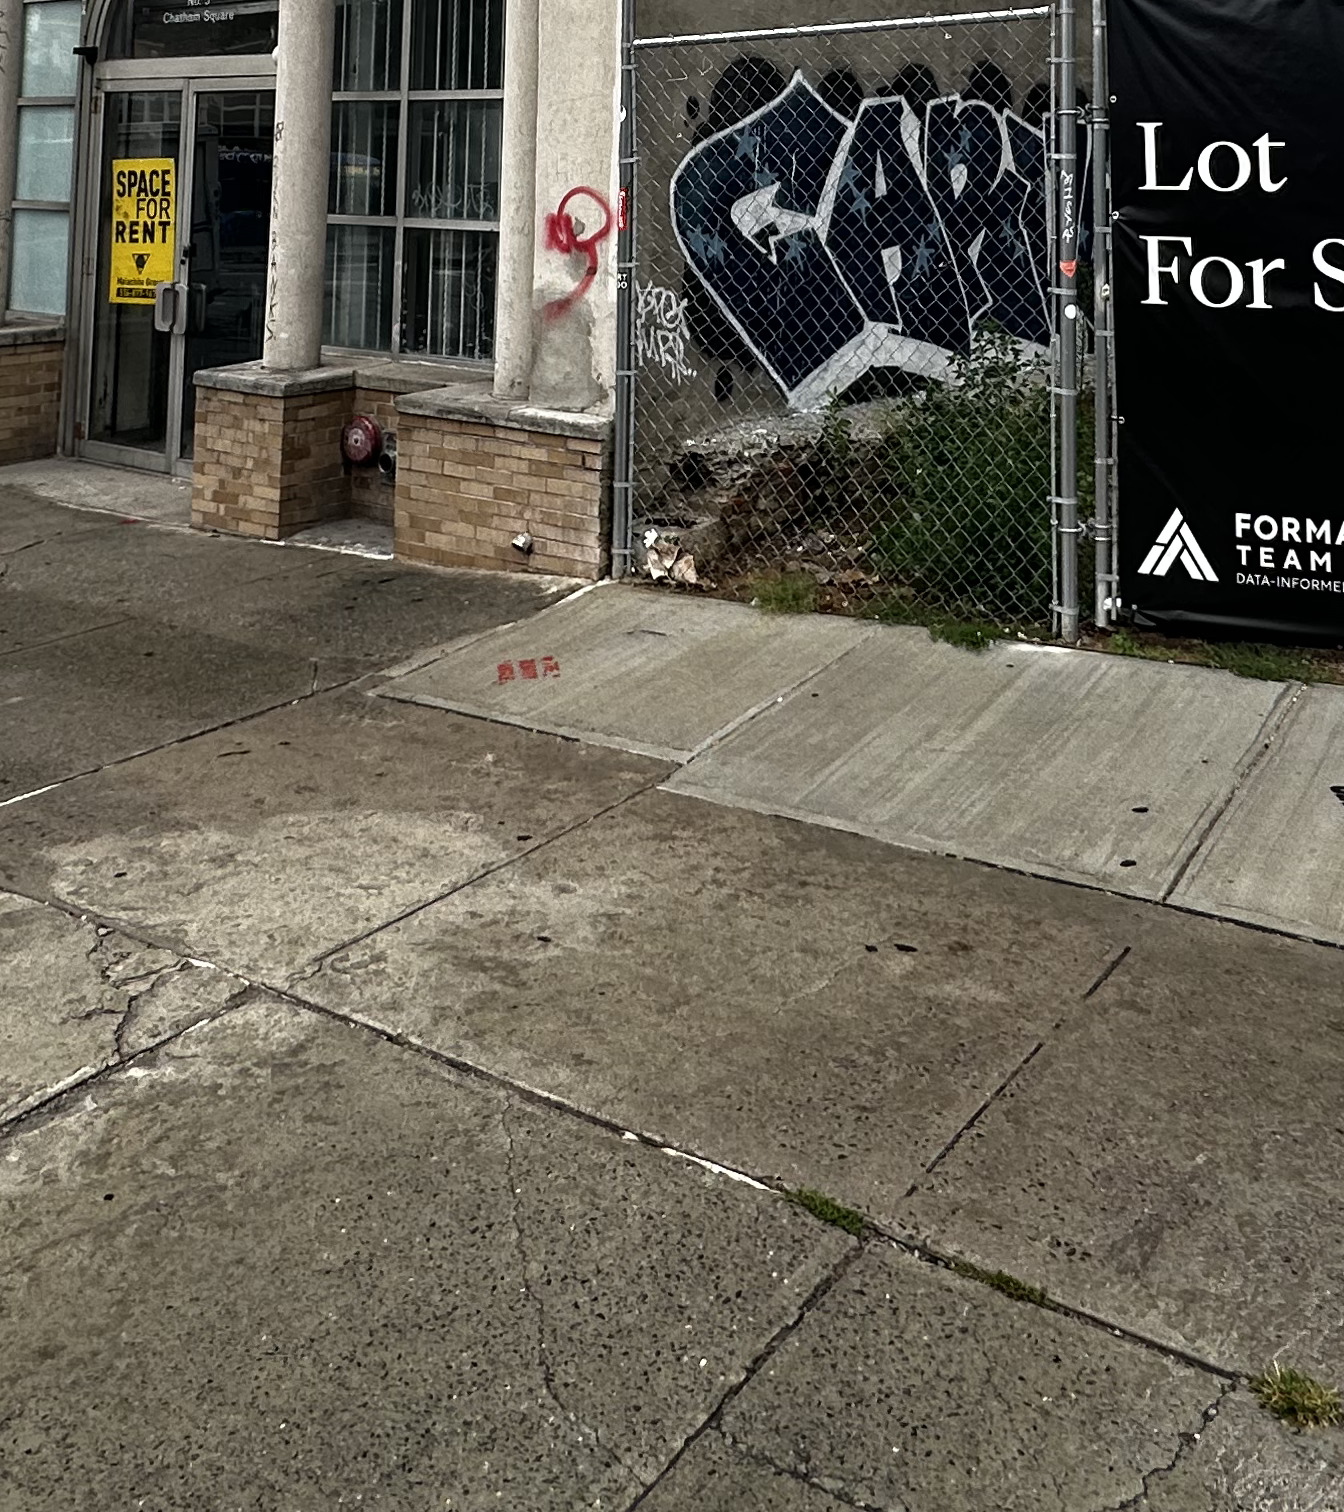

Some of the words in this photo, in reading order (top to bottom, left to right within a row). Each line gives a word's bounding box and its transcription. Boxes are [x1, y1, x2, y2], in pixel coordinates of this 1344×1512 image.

[203, 10, 235, 23] Square
[1136, 121, 1289, 194] Lot
[116, 169, 171, 198] SPACE
[136, 197, 171, 219] FOR
[116, 220, 171, 243] RENT
[1139, 234, 1285, 310] For
[1236, 545, 1332, 573] TEAM
